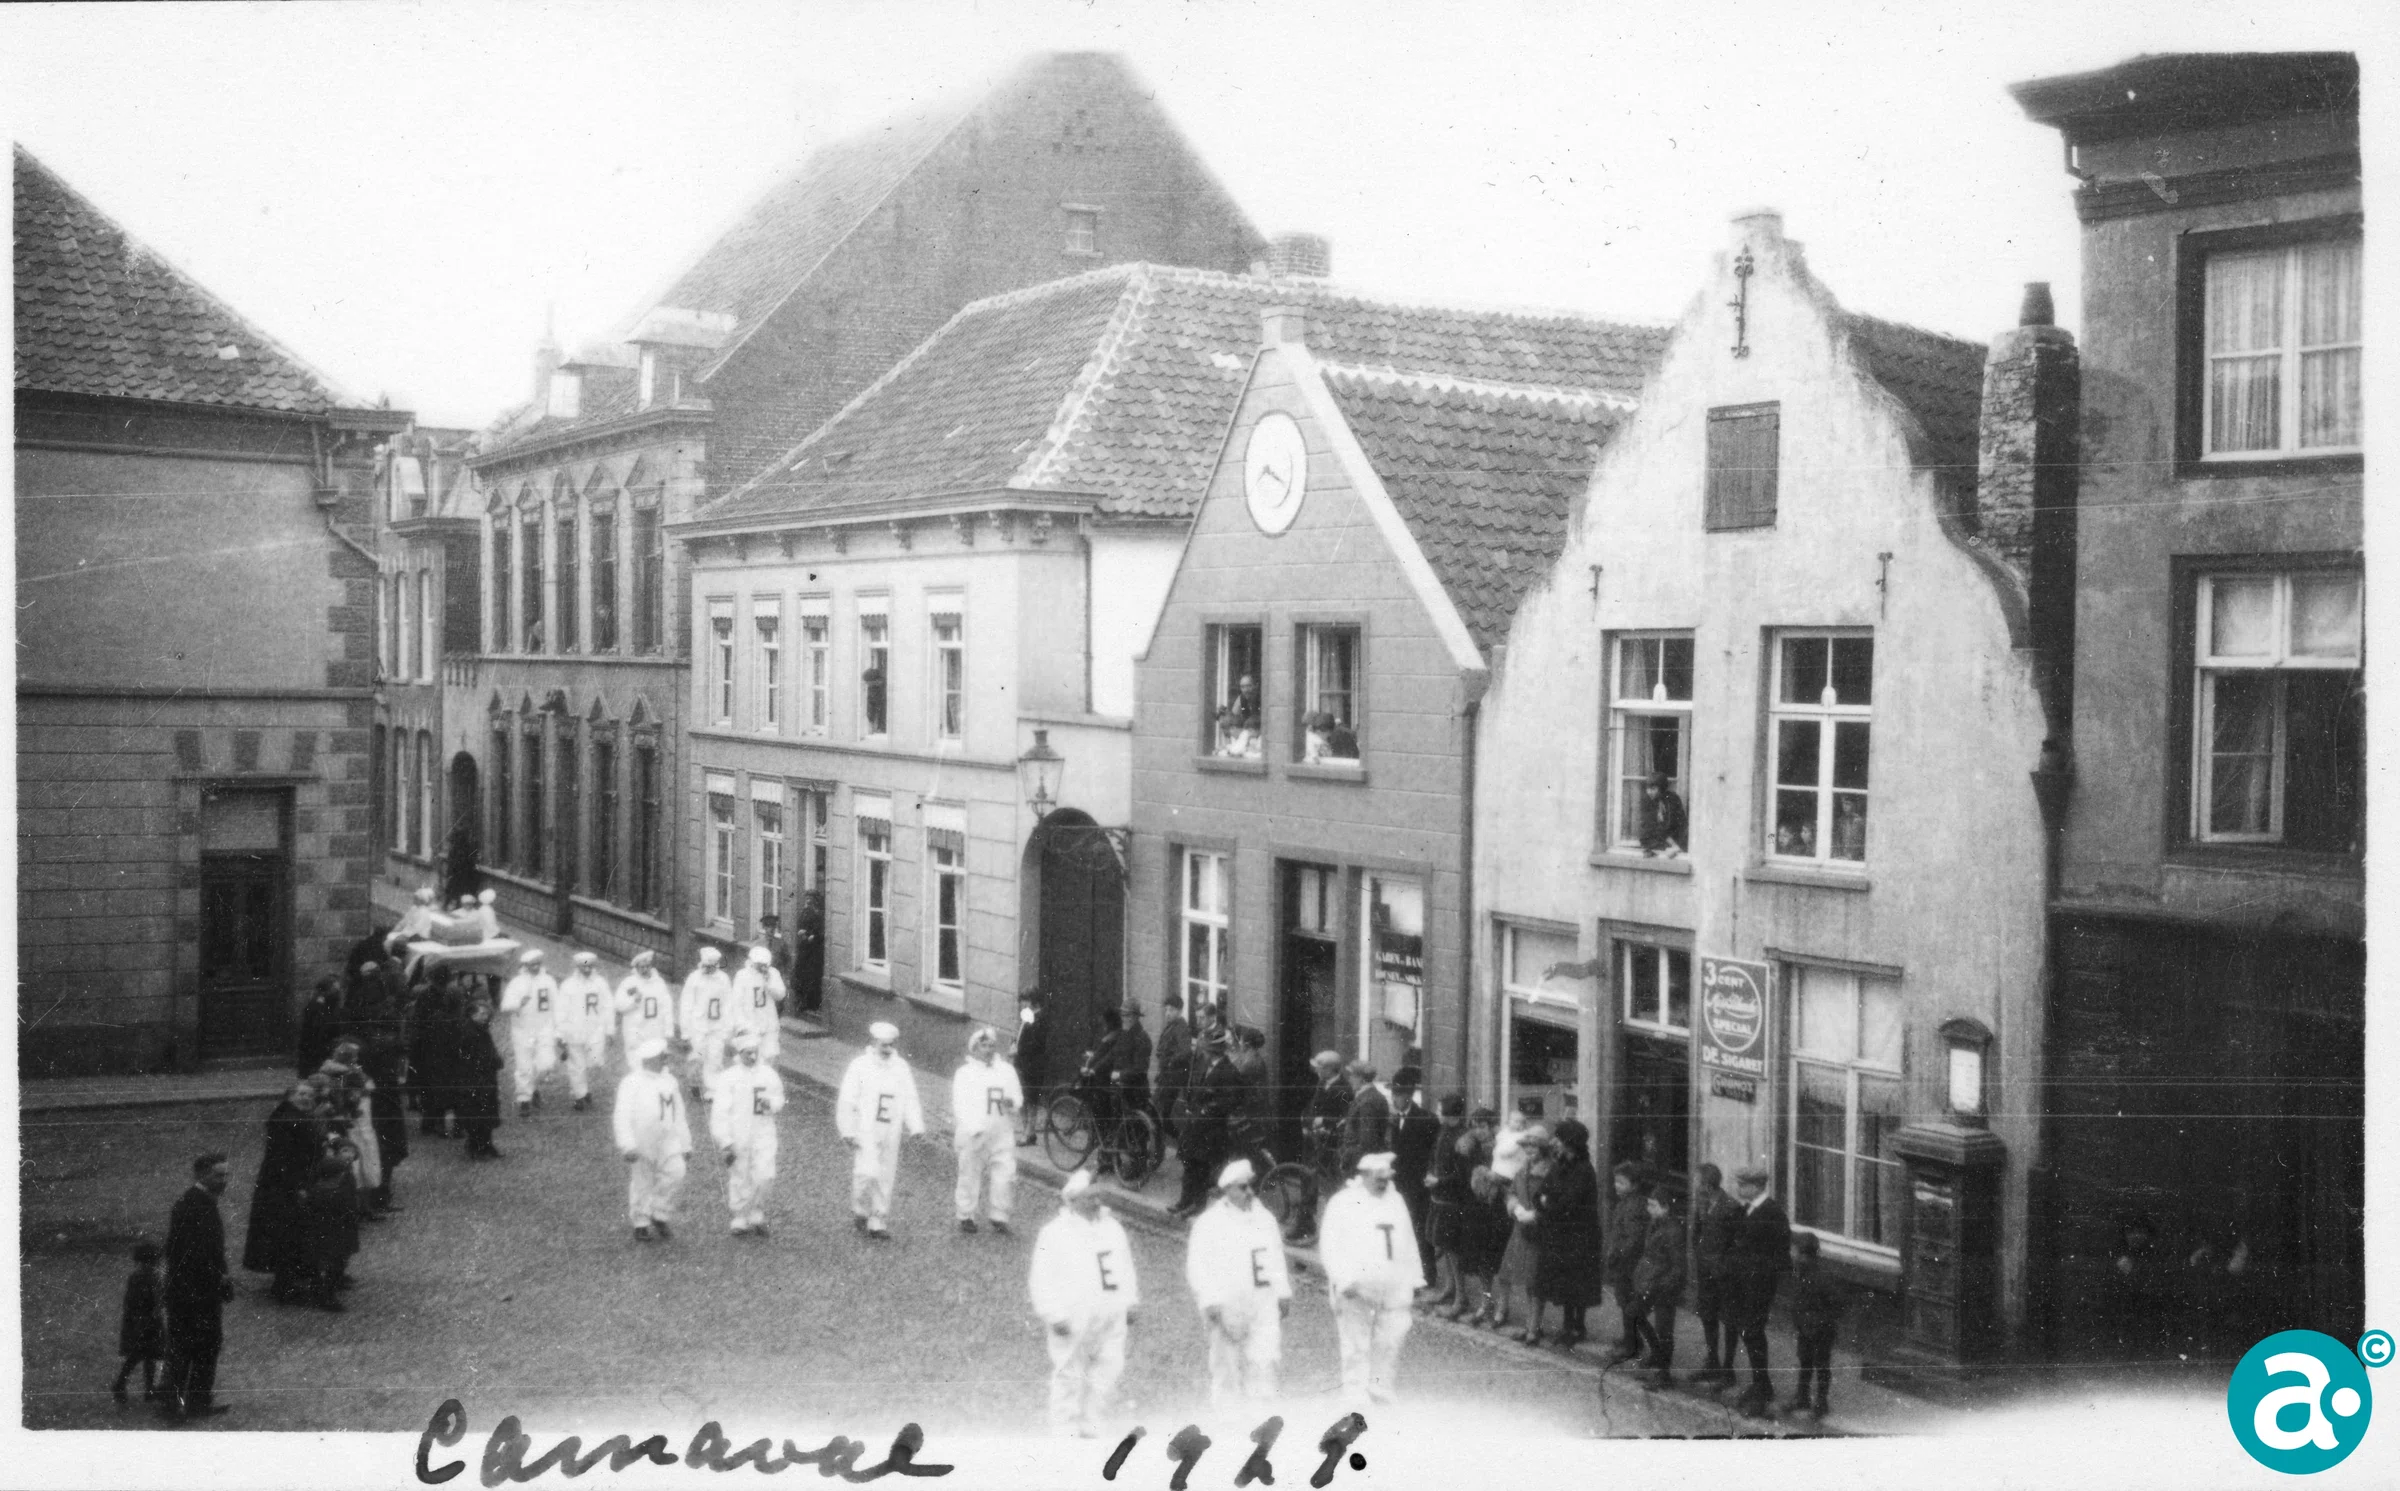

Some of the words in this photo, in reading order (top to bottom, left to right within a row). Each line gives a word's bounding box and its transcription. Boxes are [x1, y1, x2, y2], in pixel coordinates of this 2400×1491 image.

[1704, 961, 1717, 986] 3
[1717, 975, 1745, 988] CENT
[585, 992, 599, 1015] R
[1712, 1018, 1753, 1034] SPECIAL
[1702, 1045, 1720, 1064] DE
[1721, 1052, 1763, 1073] SIGARET
[659, 1093, 675, 1121] M
[753, 1086, 768, 1115] E
[876, 1093, 894, 1123] E
[987, 1087, 1004, 1116] R
[1376, 1223, 1394, 1261] T
[1097, 1250, 1118, 1291] E
[1251, 1248, 1271, 1288] E
